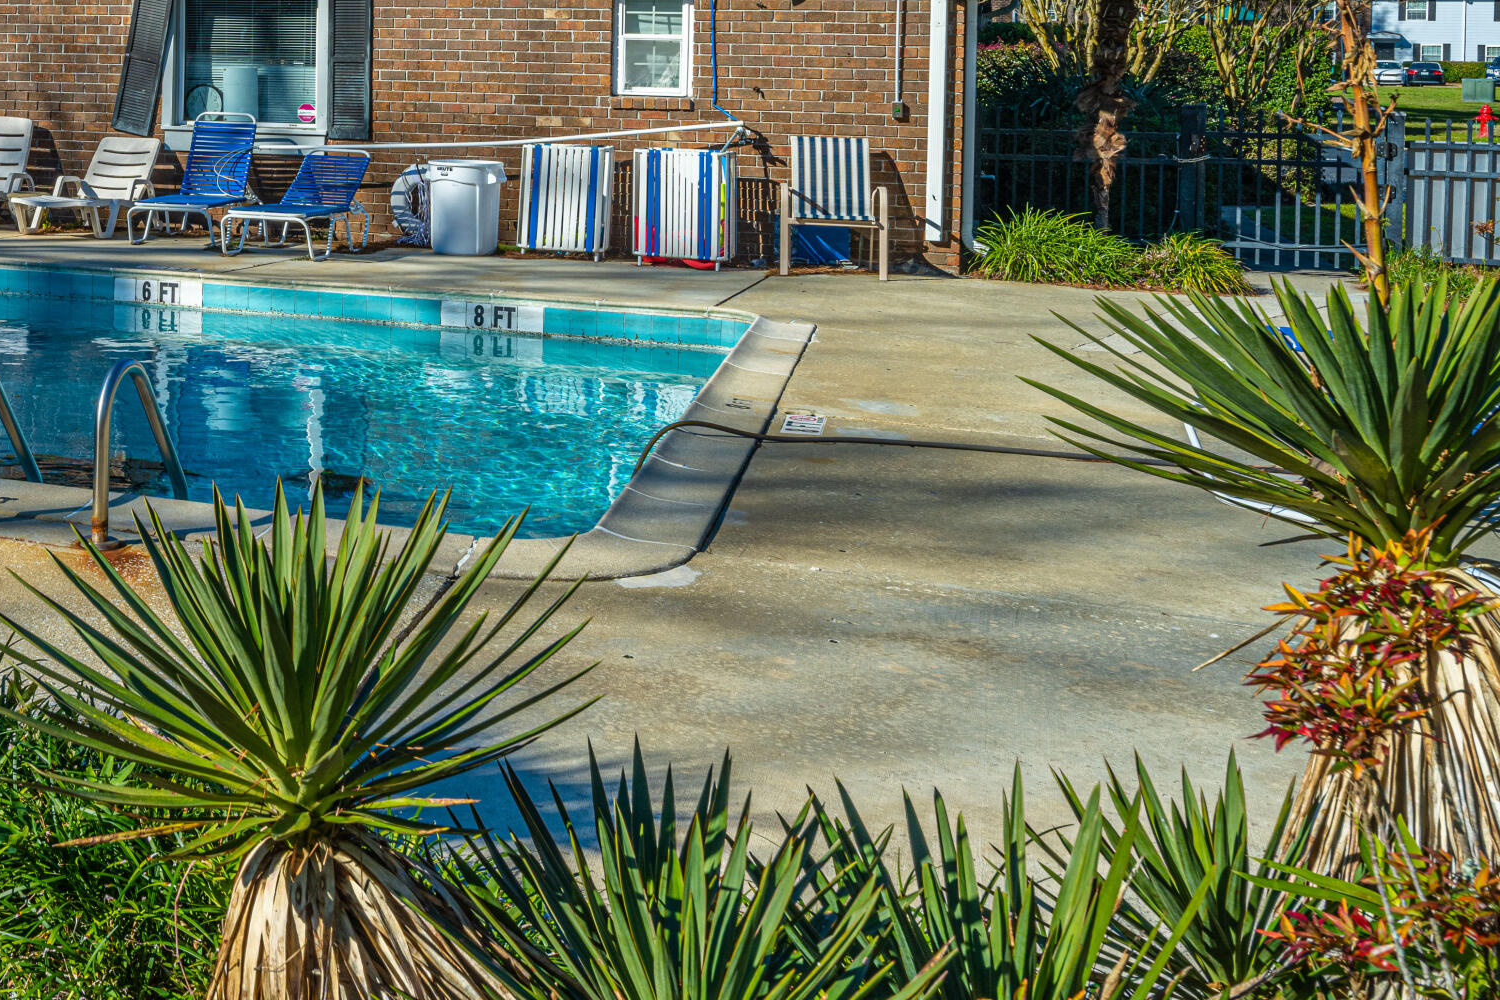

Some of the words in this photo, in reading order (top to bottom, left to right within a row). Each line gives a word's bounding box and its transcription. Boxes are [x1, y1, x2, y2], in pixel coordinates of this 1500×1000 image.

[142, 281, 151, 301] 6
[159, 282, 178, 303] FT
[474, 304, 484, 327] 8
[493, 306, 516, 329] FT
